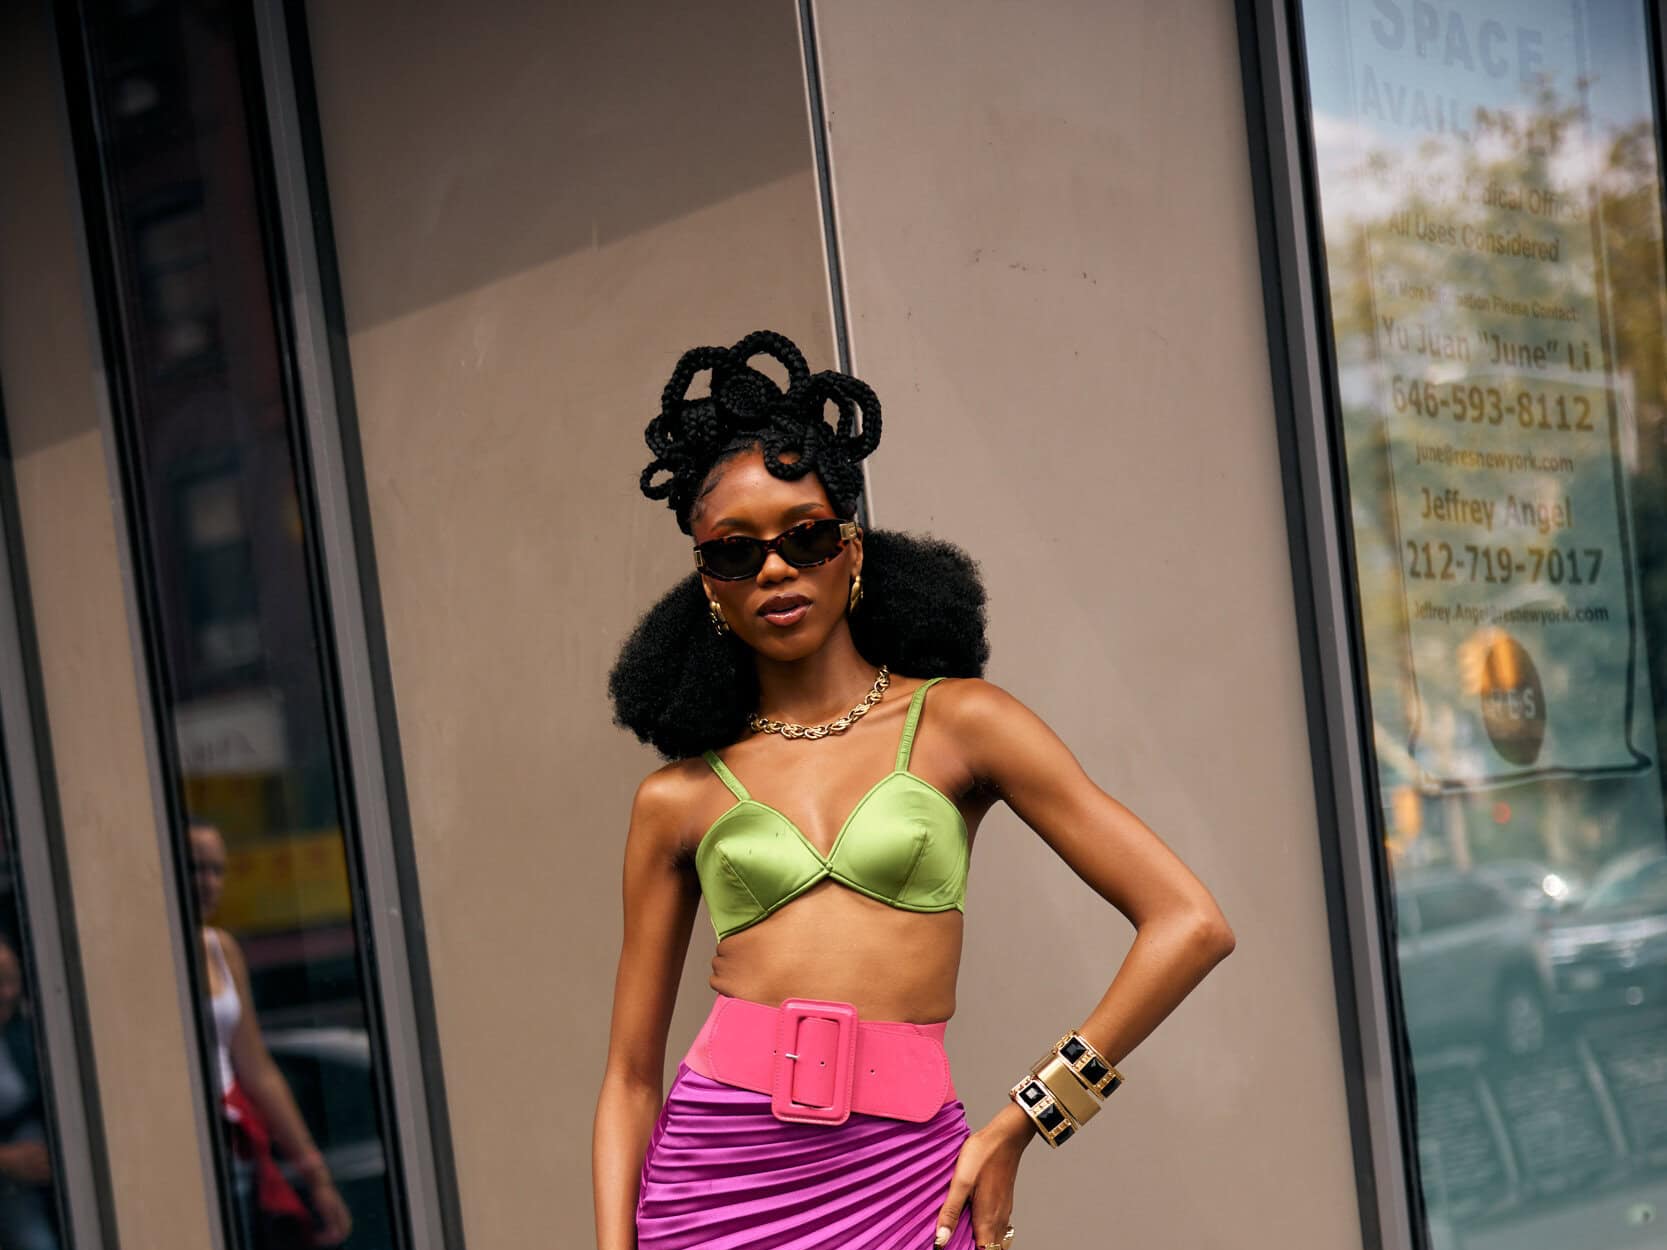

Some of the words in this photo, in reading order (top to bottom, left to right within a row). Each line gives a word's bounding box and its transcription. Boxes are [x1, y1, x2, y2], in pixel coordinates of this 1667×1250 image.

[1370, 0, 1544, 85] SPACE
[1389, 210, 1410, 237] All
[1415, 211, 1457, 246] Uses
[1462, 223, 1561, 263] Considered
[1382, 314, 1409, 350] Yu
[1418, 323, 1471, 363] Juan
[1478, 329, 1558, 370] "June"
[1567, 339, 1592, 373] Li
[1392, 375, 1595, 433] 646-593-8112
[1421, 486, 1496, 532] Jeffrey
[1505, 493, 1573, 535] Angel
[1406, 539, 1605, 587] 212-719-7017
